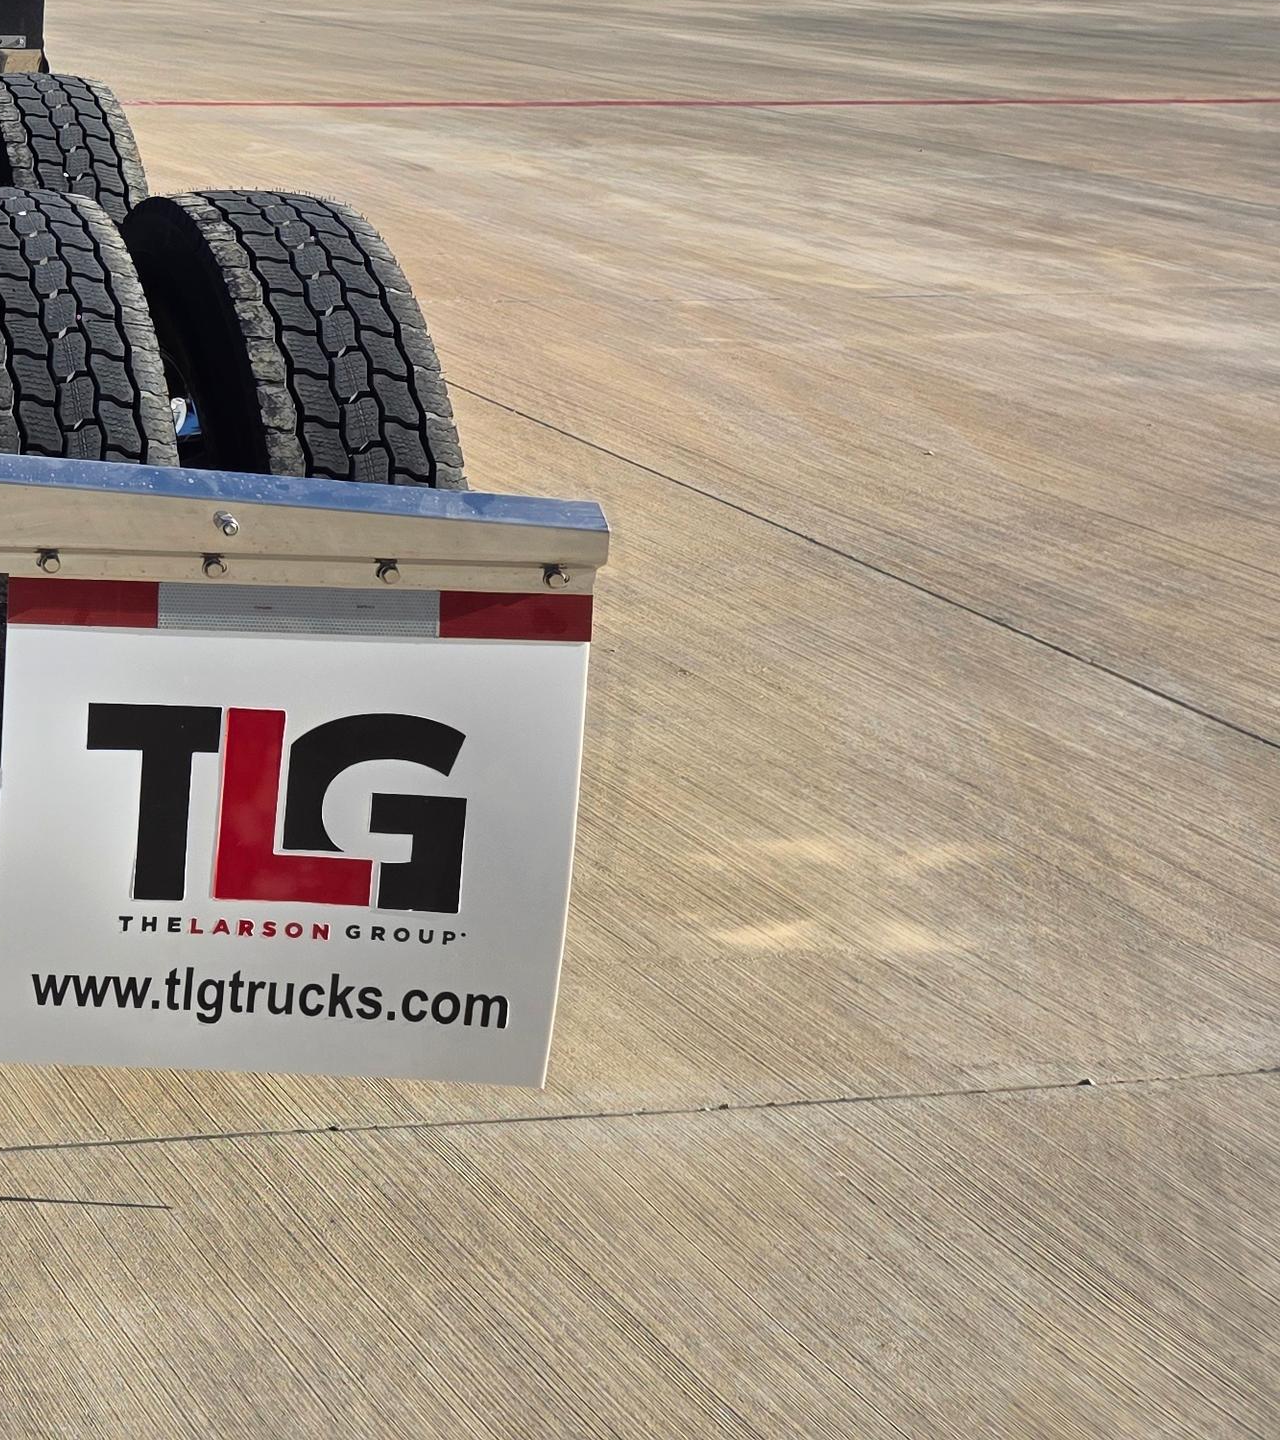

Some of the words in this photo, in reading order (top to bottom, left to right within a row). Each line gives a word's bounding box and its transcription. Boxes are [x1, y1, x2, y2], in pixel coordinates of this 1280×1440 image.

[86, 702, 468, 915] TLG
[345, 924, 456, 946] GROUP
[31, 966, 509, 1031] www.tlgtrucks.com
